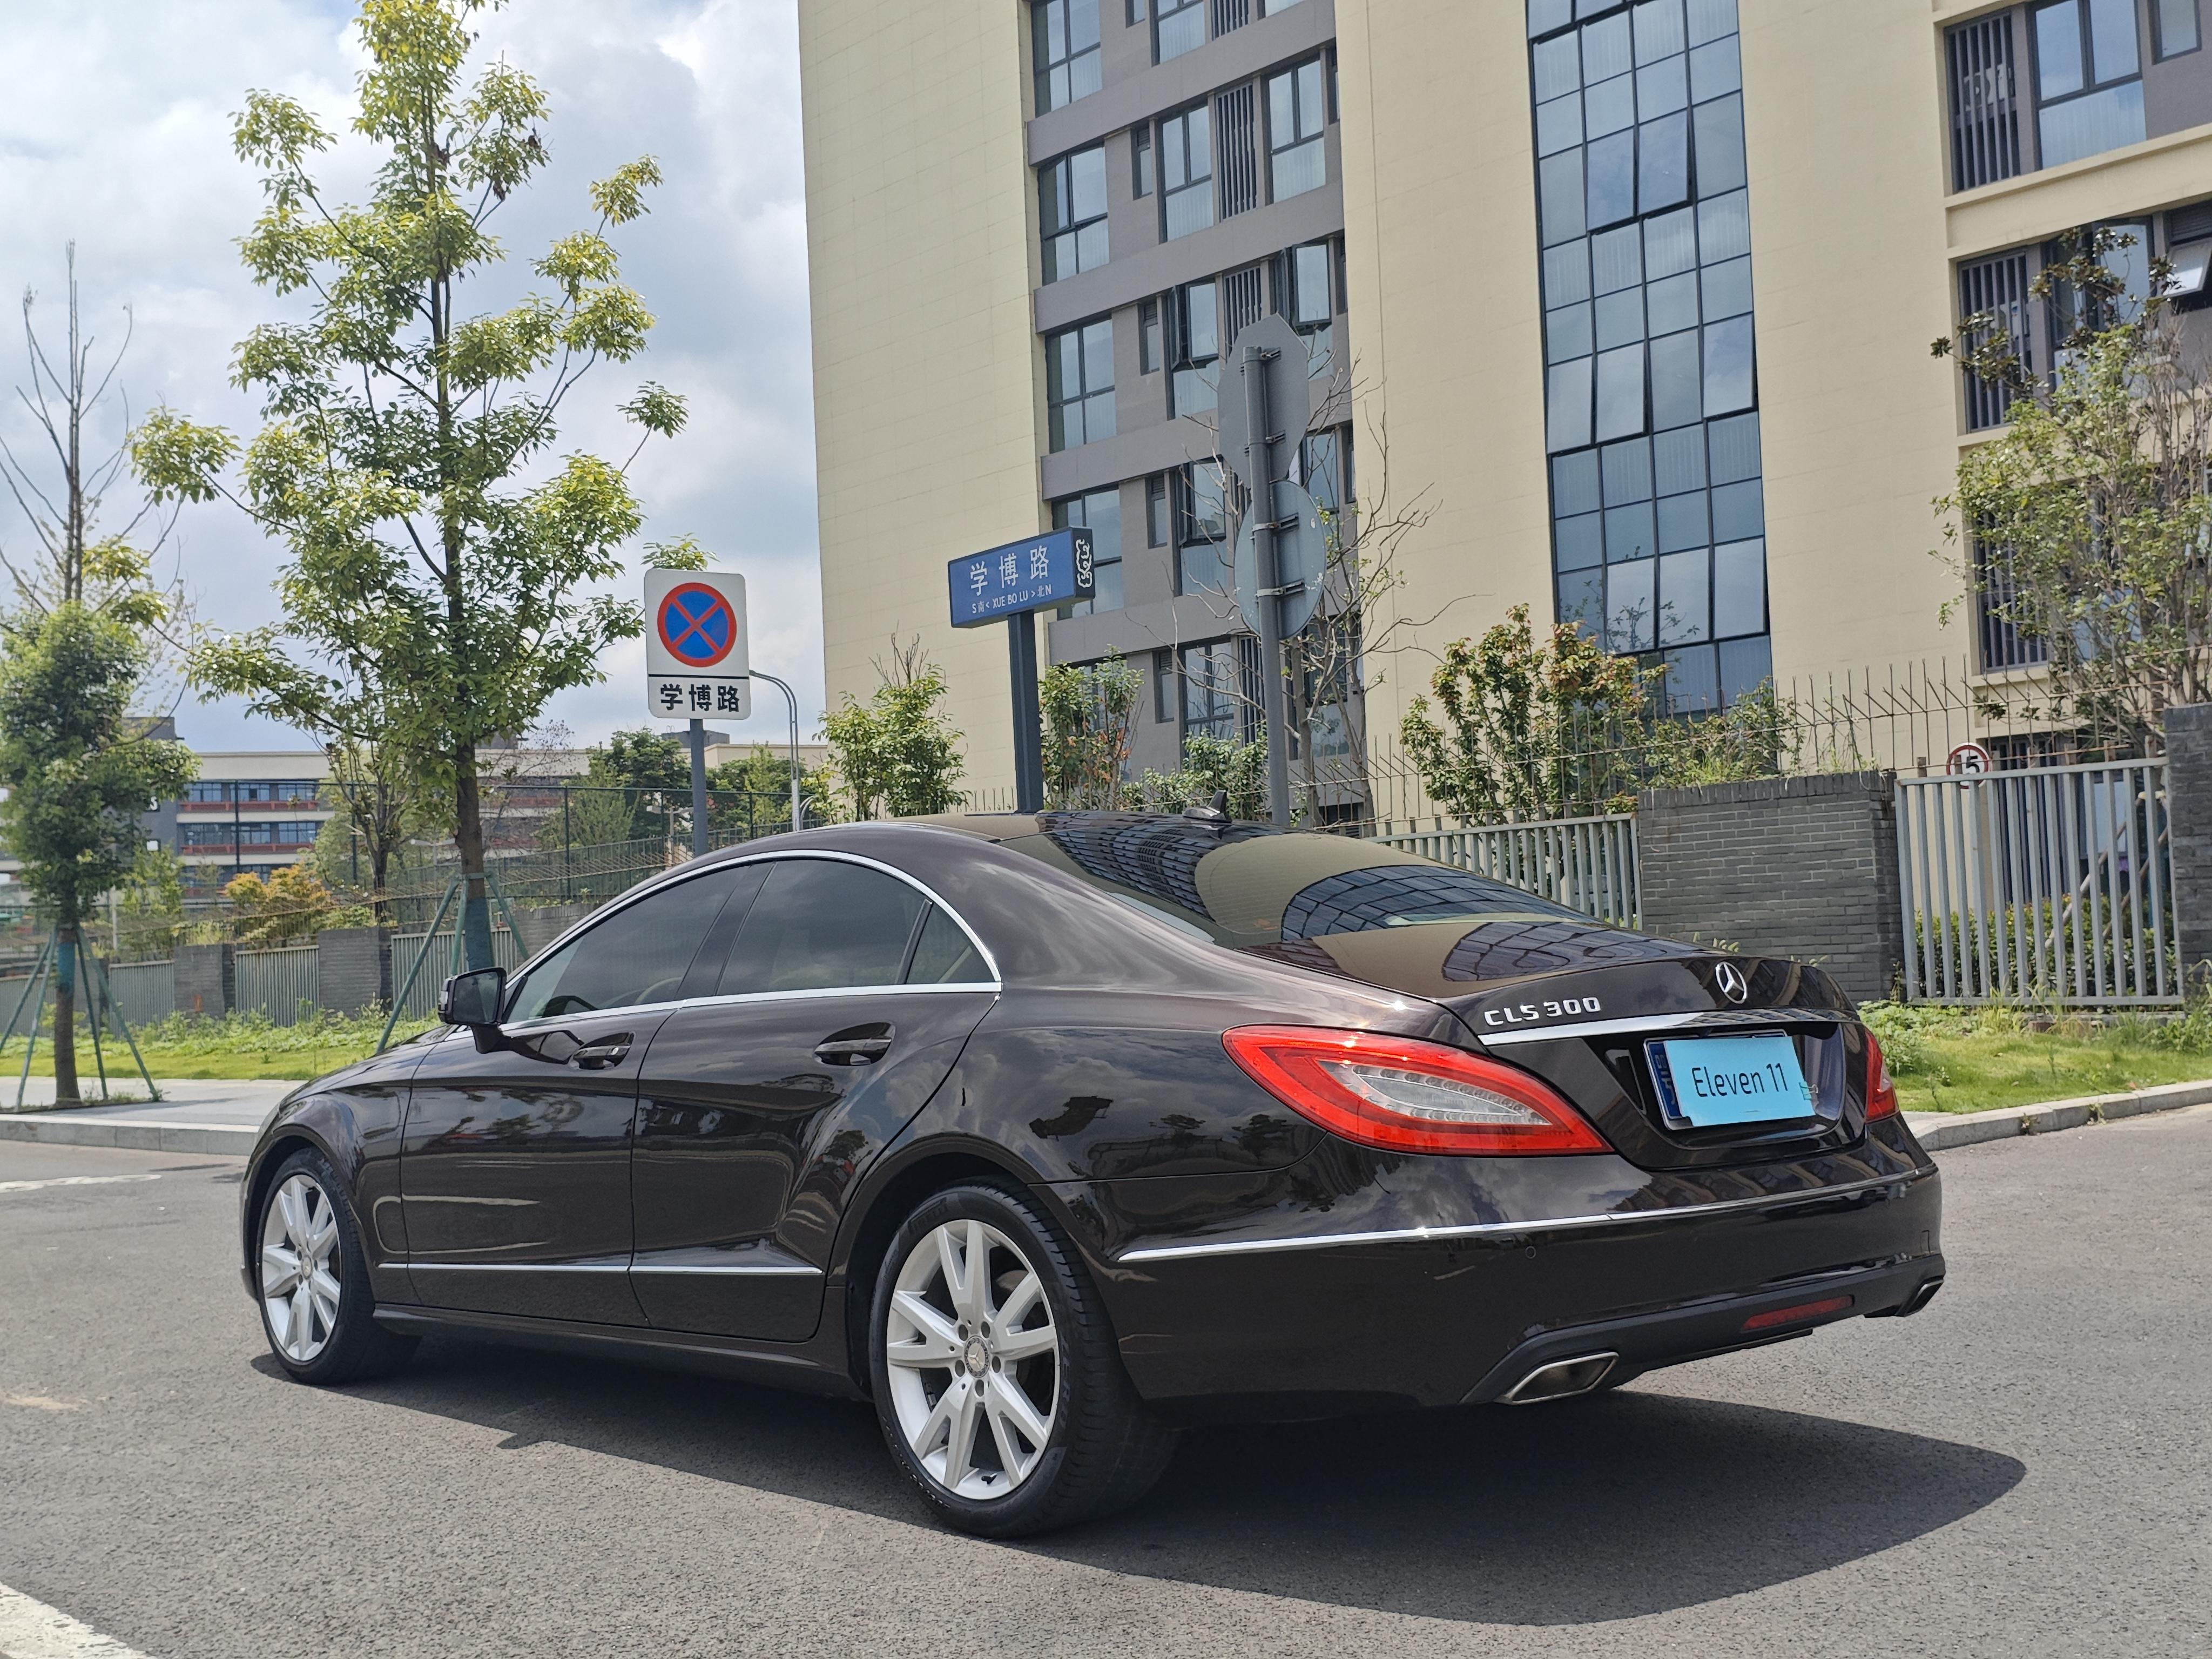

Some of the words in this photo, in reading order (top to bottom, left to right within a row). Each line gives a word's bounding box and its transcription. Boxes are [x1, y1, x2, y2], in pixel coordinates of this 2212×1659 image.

[970, 544, 1049, 596] 学博路
[993, 596, 1006, 609] XUE
[1008, 593, 1017, 605] BO
[1020, 590, 1028, 602] LU
[660, 683, 740, 712] 学博路
[1484, 1004, 1540, 1027] CLS
[1543, 996, 1602, 1018] 300
[1691, 1067, 1765, 1098] Eleven
[1767, 1062, 1789, 1093] 11
